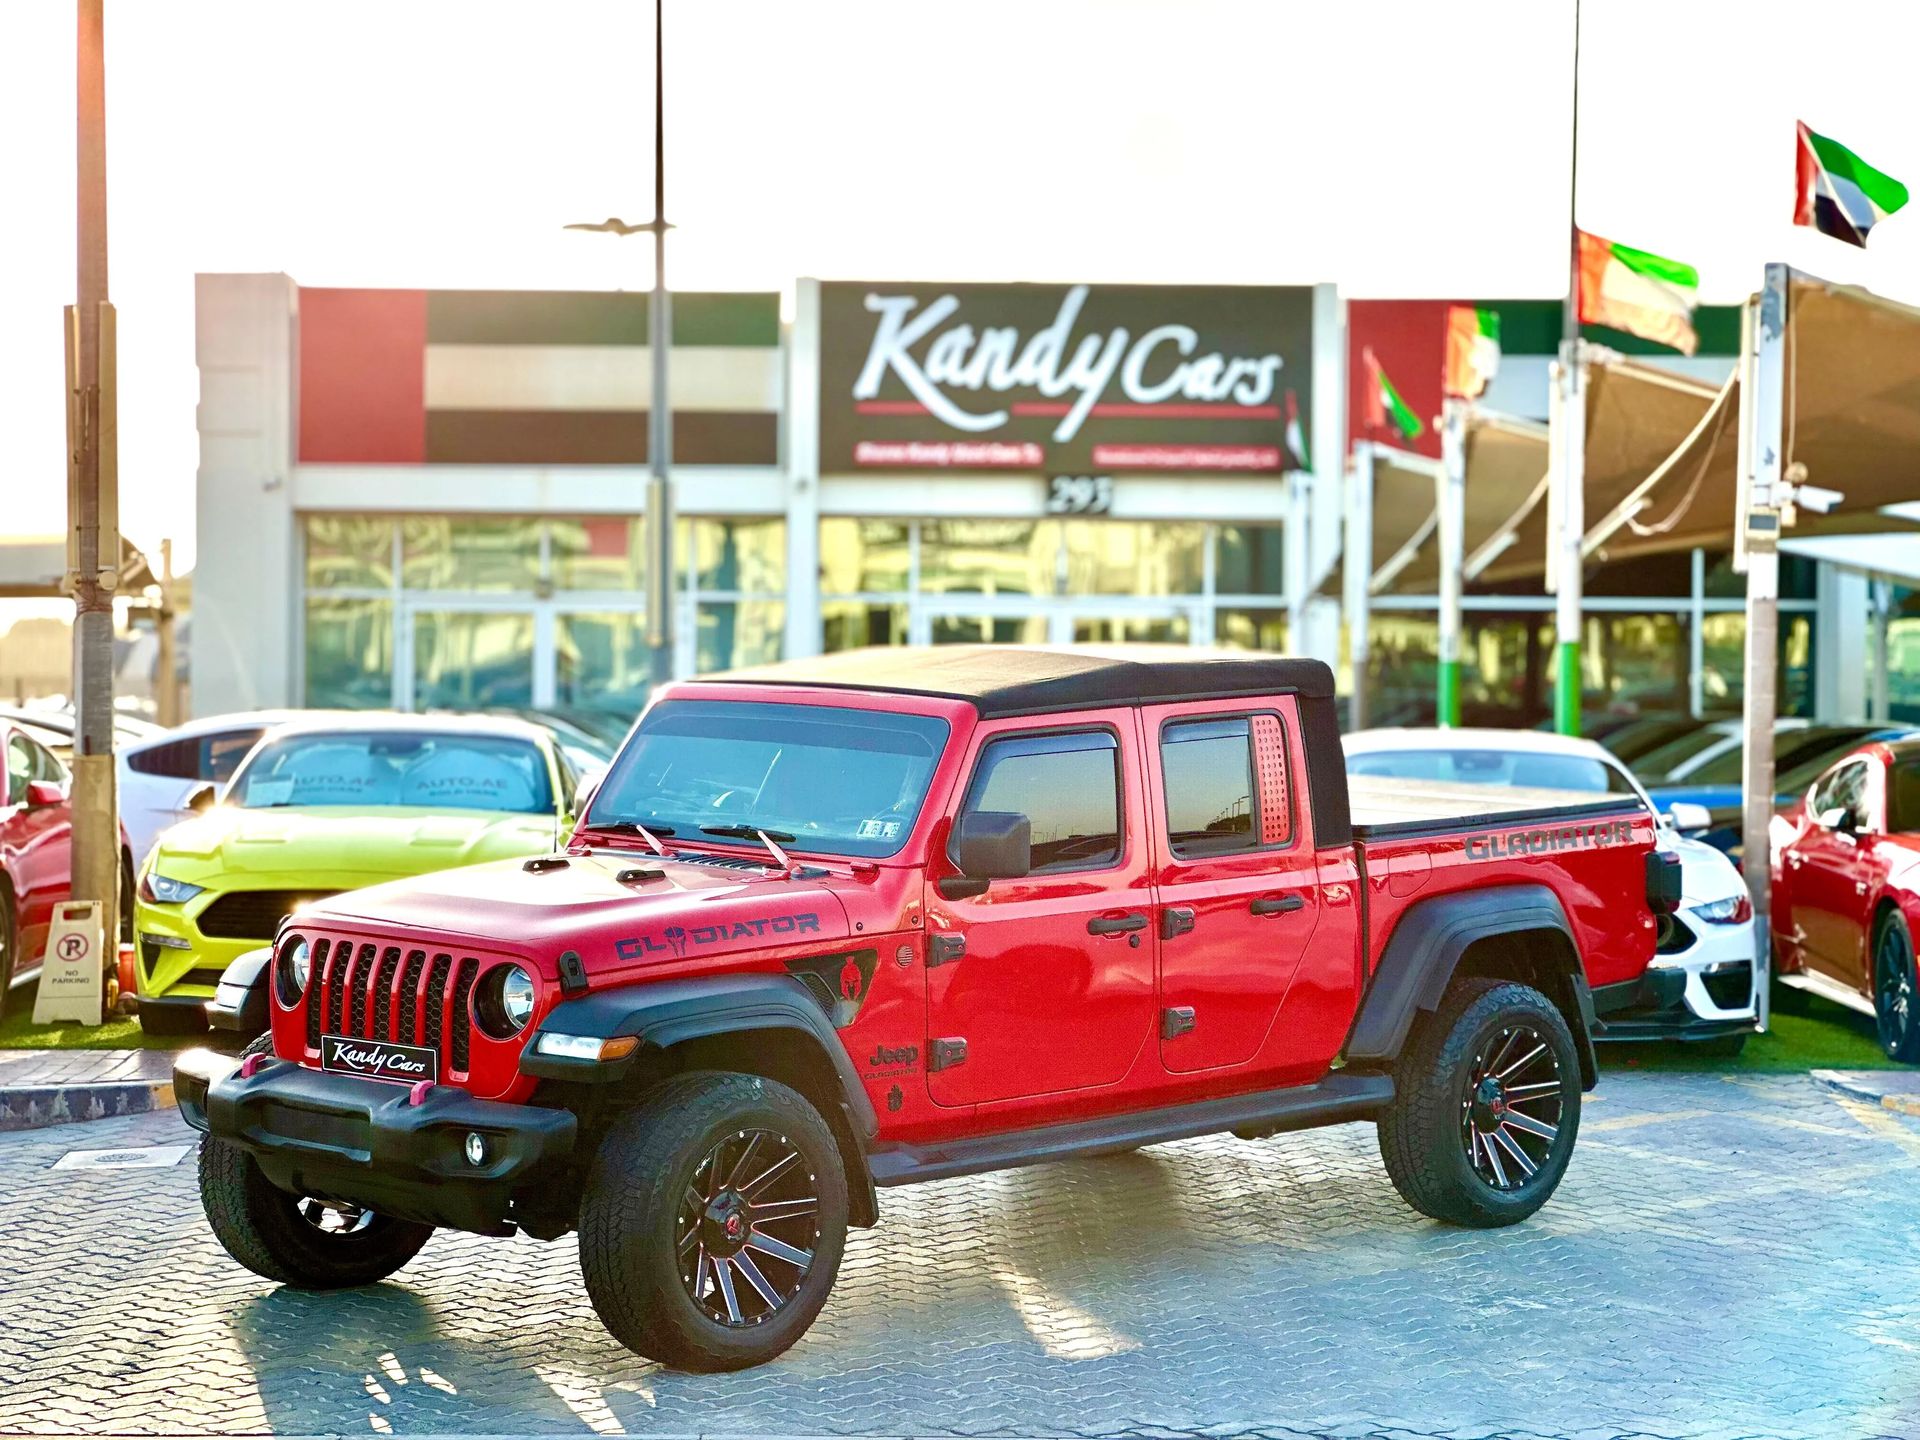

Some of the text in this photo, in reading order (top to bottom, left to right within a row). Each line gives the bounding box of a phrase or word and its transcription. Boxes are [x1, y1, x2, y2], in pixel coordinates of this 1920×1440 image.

[853, 284, 1284, 443] Kandy Cars
[1464, 821, 1635, 861] GLADIATOR
[51, 977, 90, 985] PARKING
[65, 969, 79, 977] NO
[332, 1041, 426, 1074] Kandy Cars
[869, 1044, 919, 1067] Jeep
